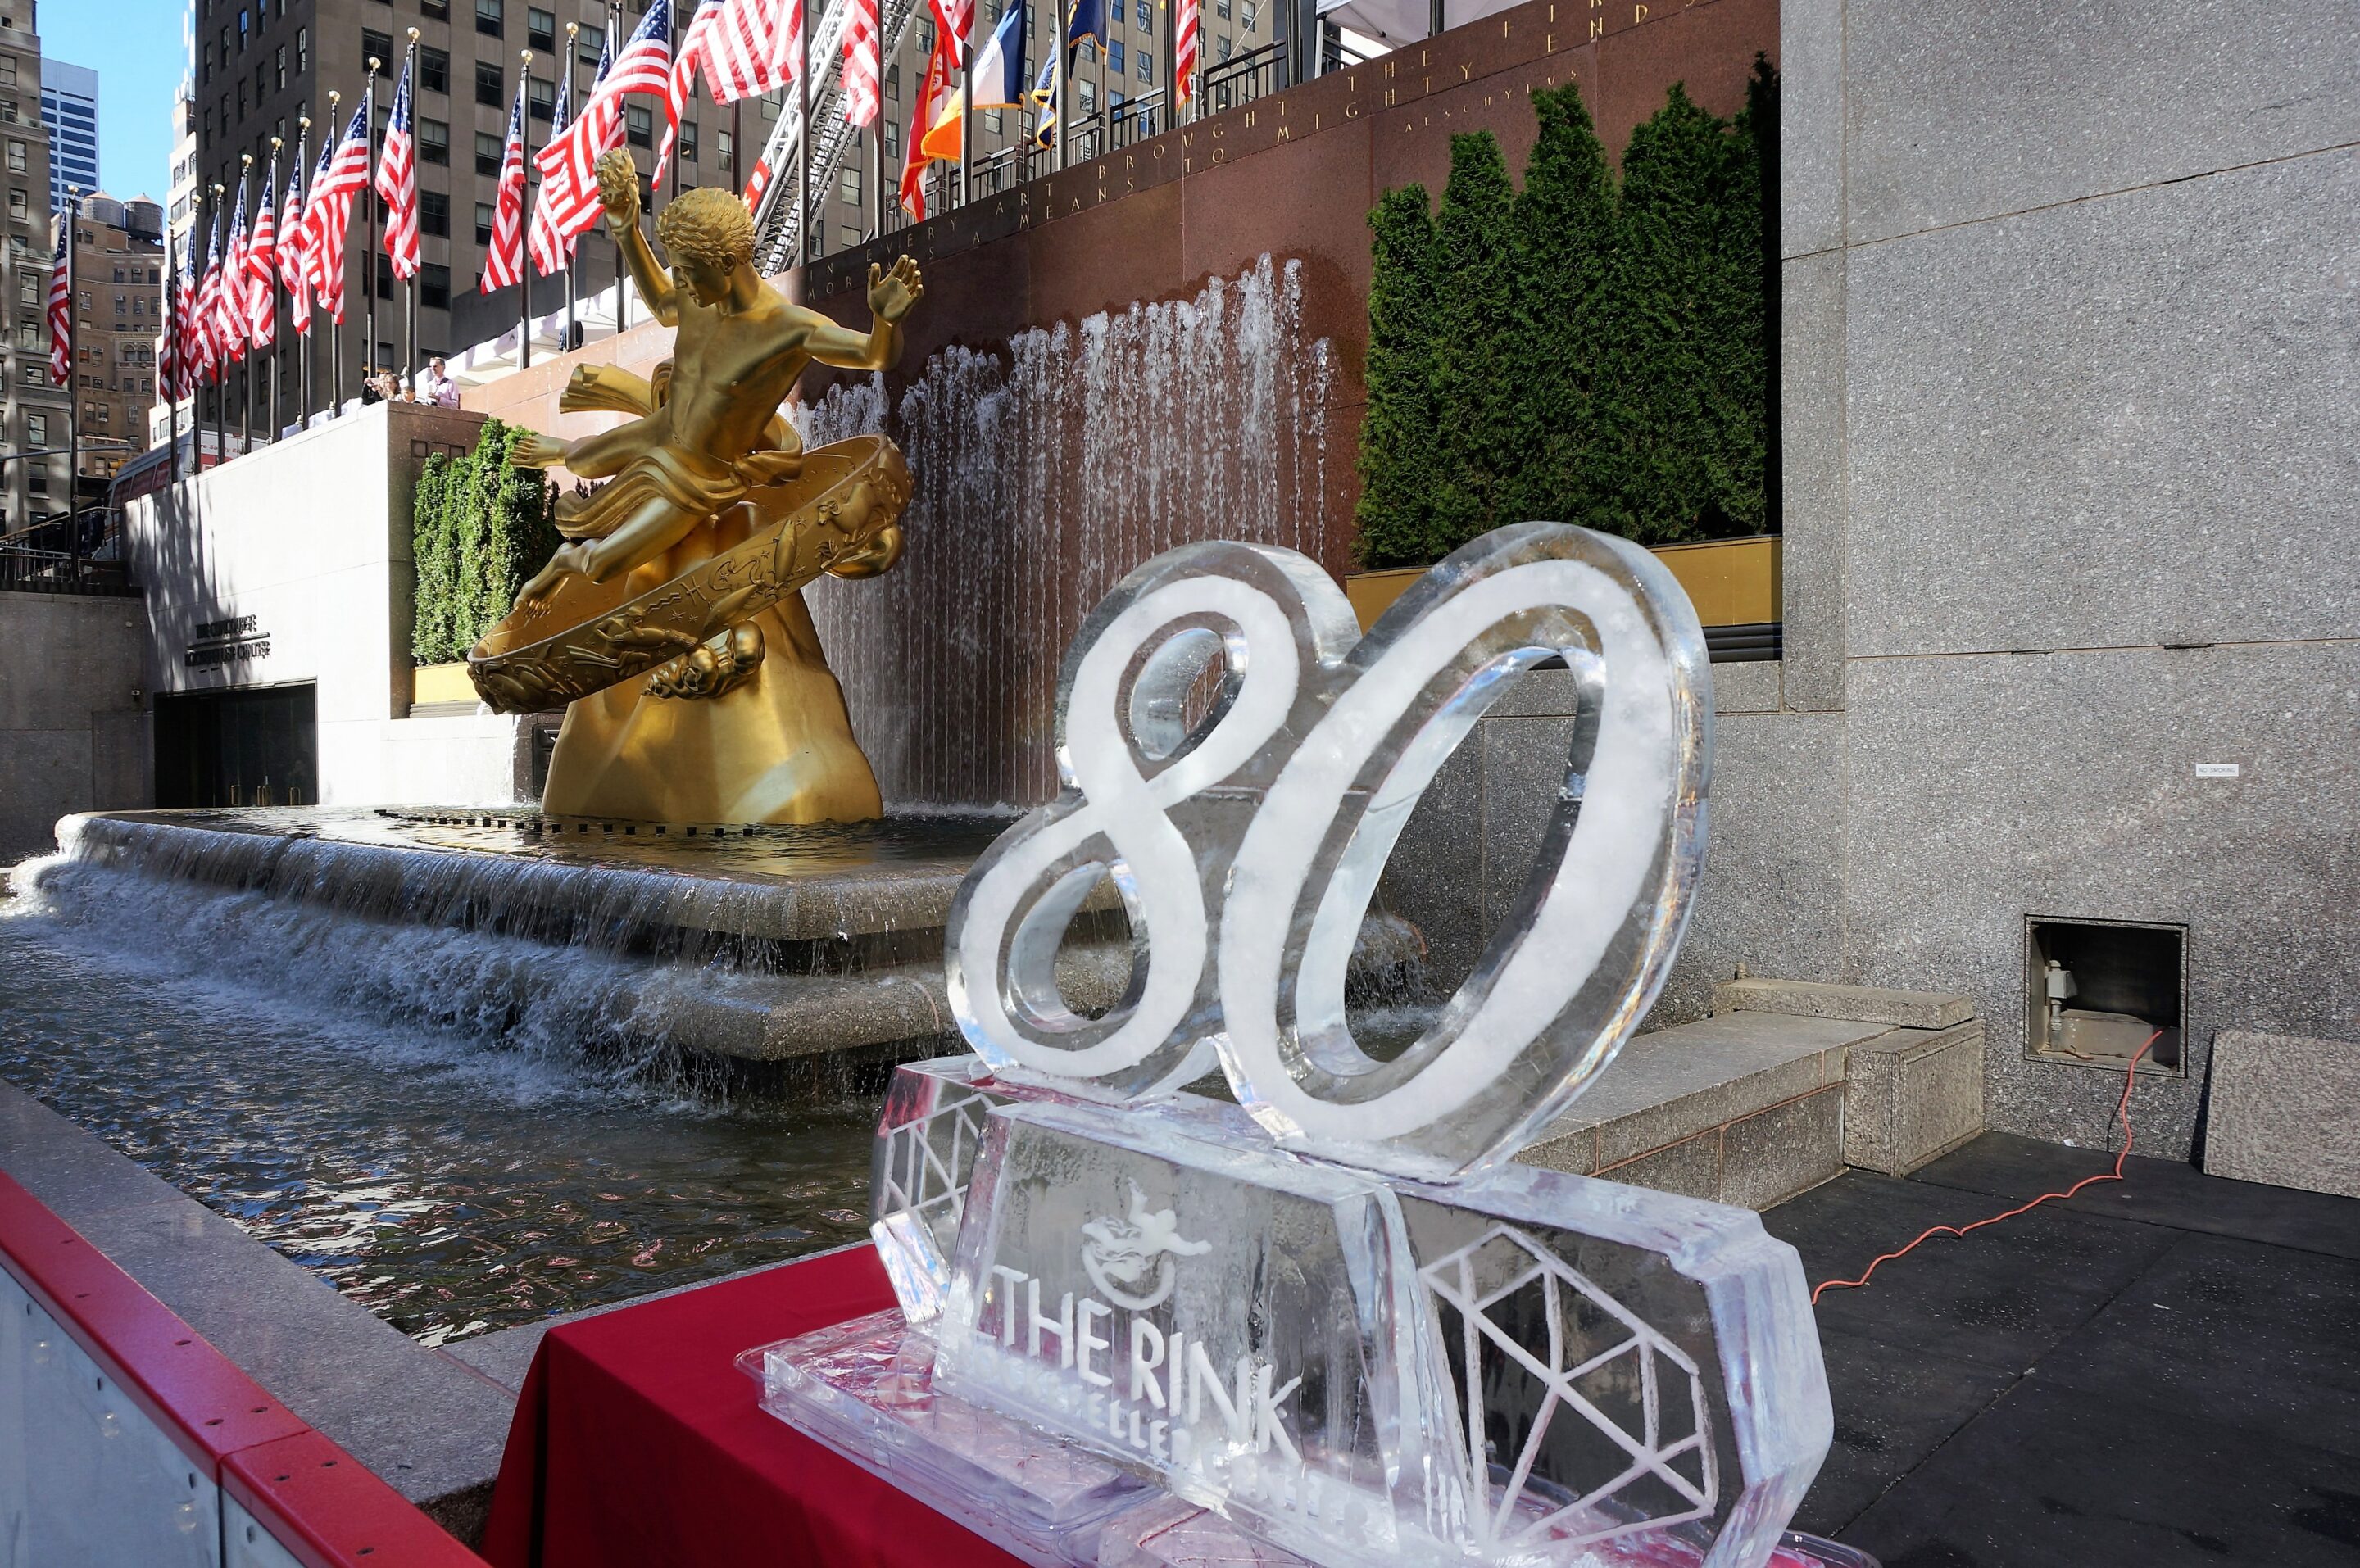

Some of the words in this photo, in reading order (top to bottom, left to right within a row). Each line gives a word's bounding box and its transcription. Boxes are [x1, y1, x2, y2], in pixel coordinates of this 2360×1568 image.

[809, 262, 833, 282] IN
[866, 216, 957, 262] EVERY
[995, 182, 1053, 215] ART
[1348, 49, 1432, 92] THE
[1019, 178, 1134, 229] MEANS
[1184, 148, 1224, 173] TO
[1276, 62, 1473, 143] MIGHTY
[955, 553, 1684, 1147] 80
[992, 1263, 1113, 1387] THE
[1130, 1316, 1302, 1465] RINK
